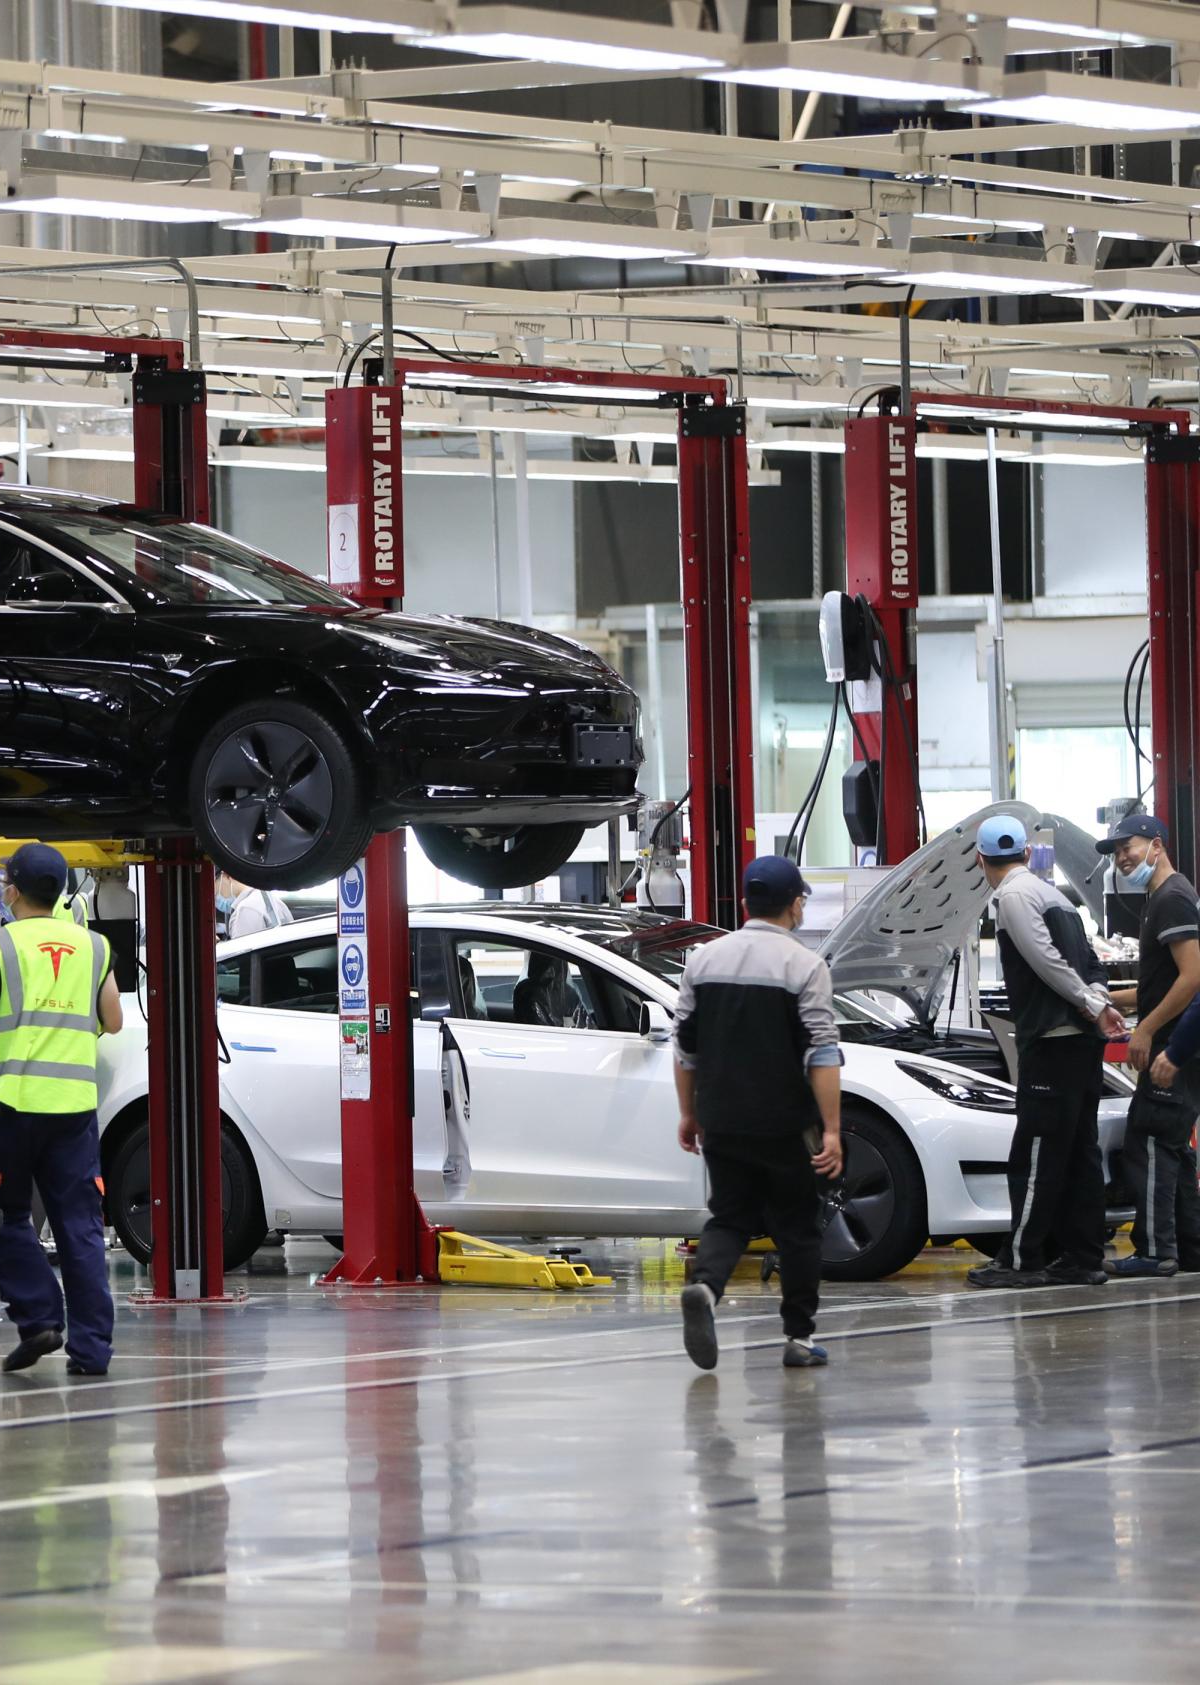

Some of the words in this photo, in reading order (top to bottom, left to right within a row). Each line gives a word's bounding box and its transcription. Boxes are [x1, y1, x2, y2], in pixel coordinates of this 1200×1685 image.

[371, 393, 392, 452] LIFT
[889, 423, 906, 476] LIFT
[339, 532, 347, 552] 2
[373, 460, 394, 570] ROTARY
[889, 483, 909, 586] ROTARY
[35, 998, 74, 1009] TESLA
